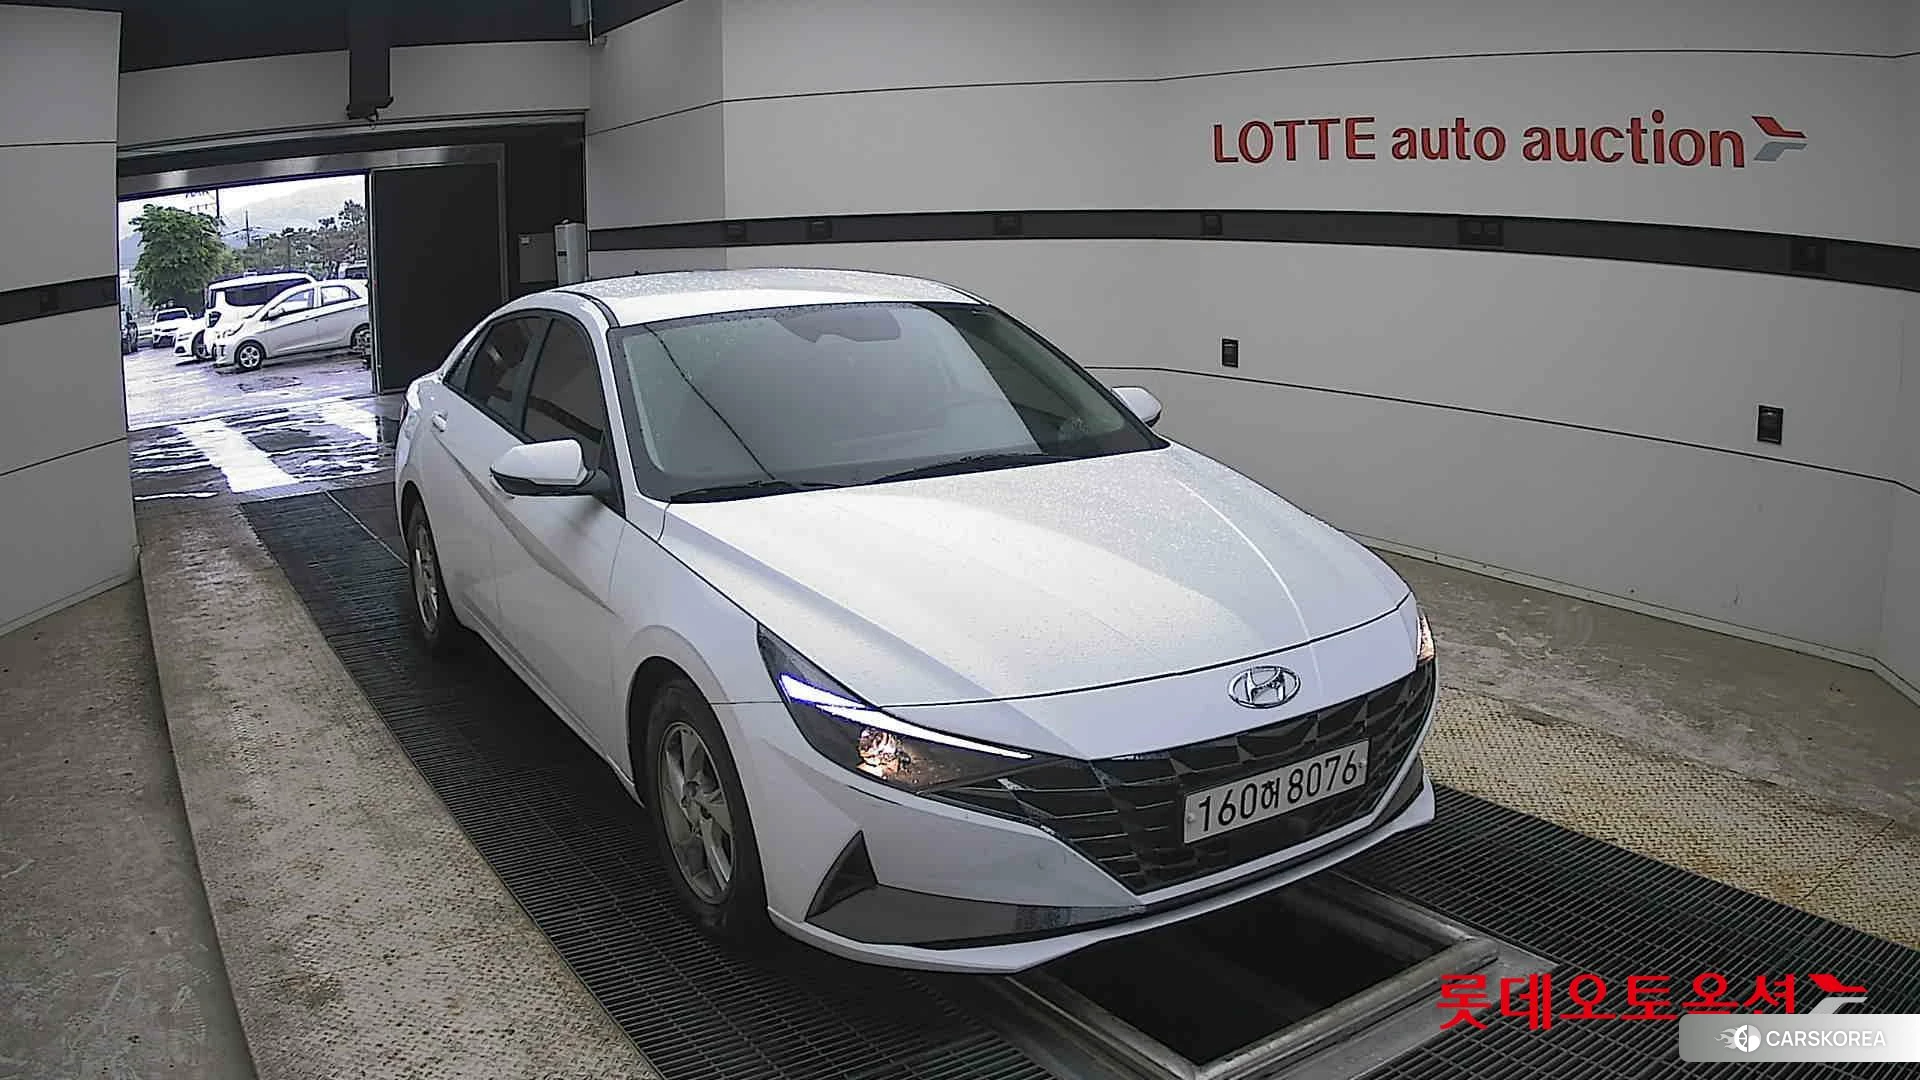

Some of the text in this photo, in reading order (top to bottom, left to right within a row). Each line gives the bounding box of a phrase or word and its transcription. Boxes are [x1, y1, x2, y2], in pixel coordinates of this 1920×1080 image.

[1211, 109, 1746, 169] LOTTE auto auction
